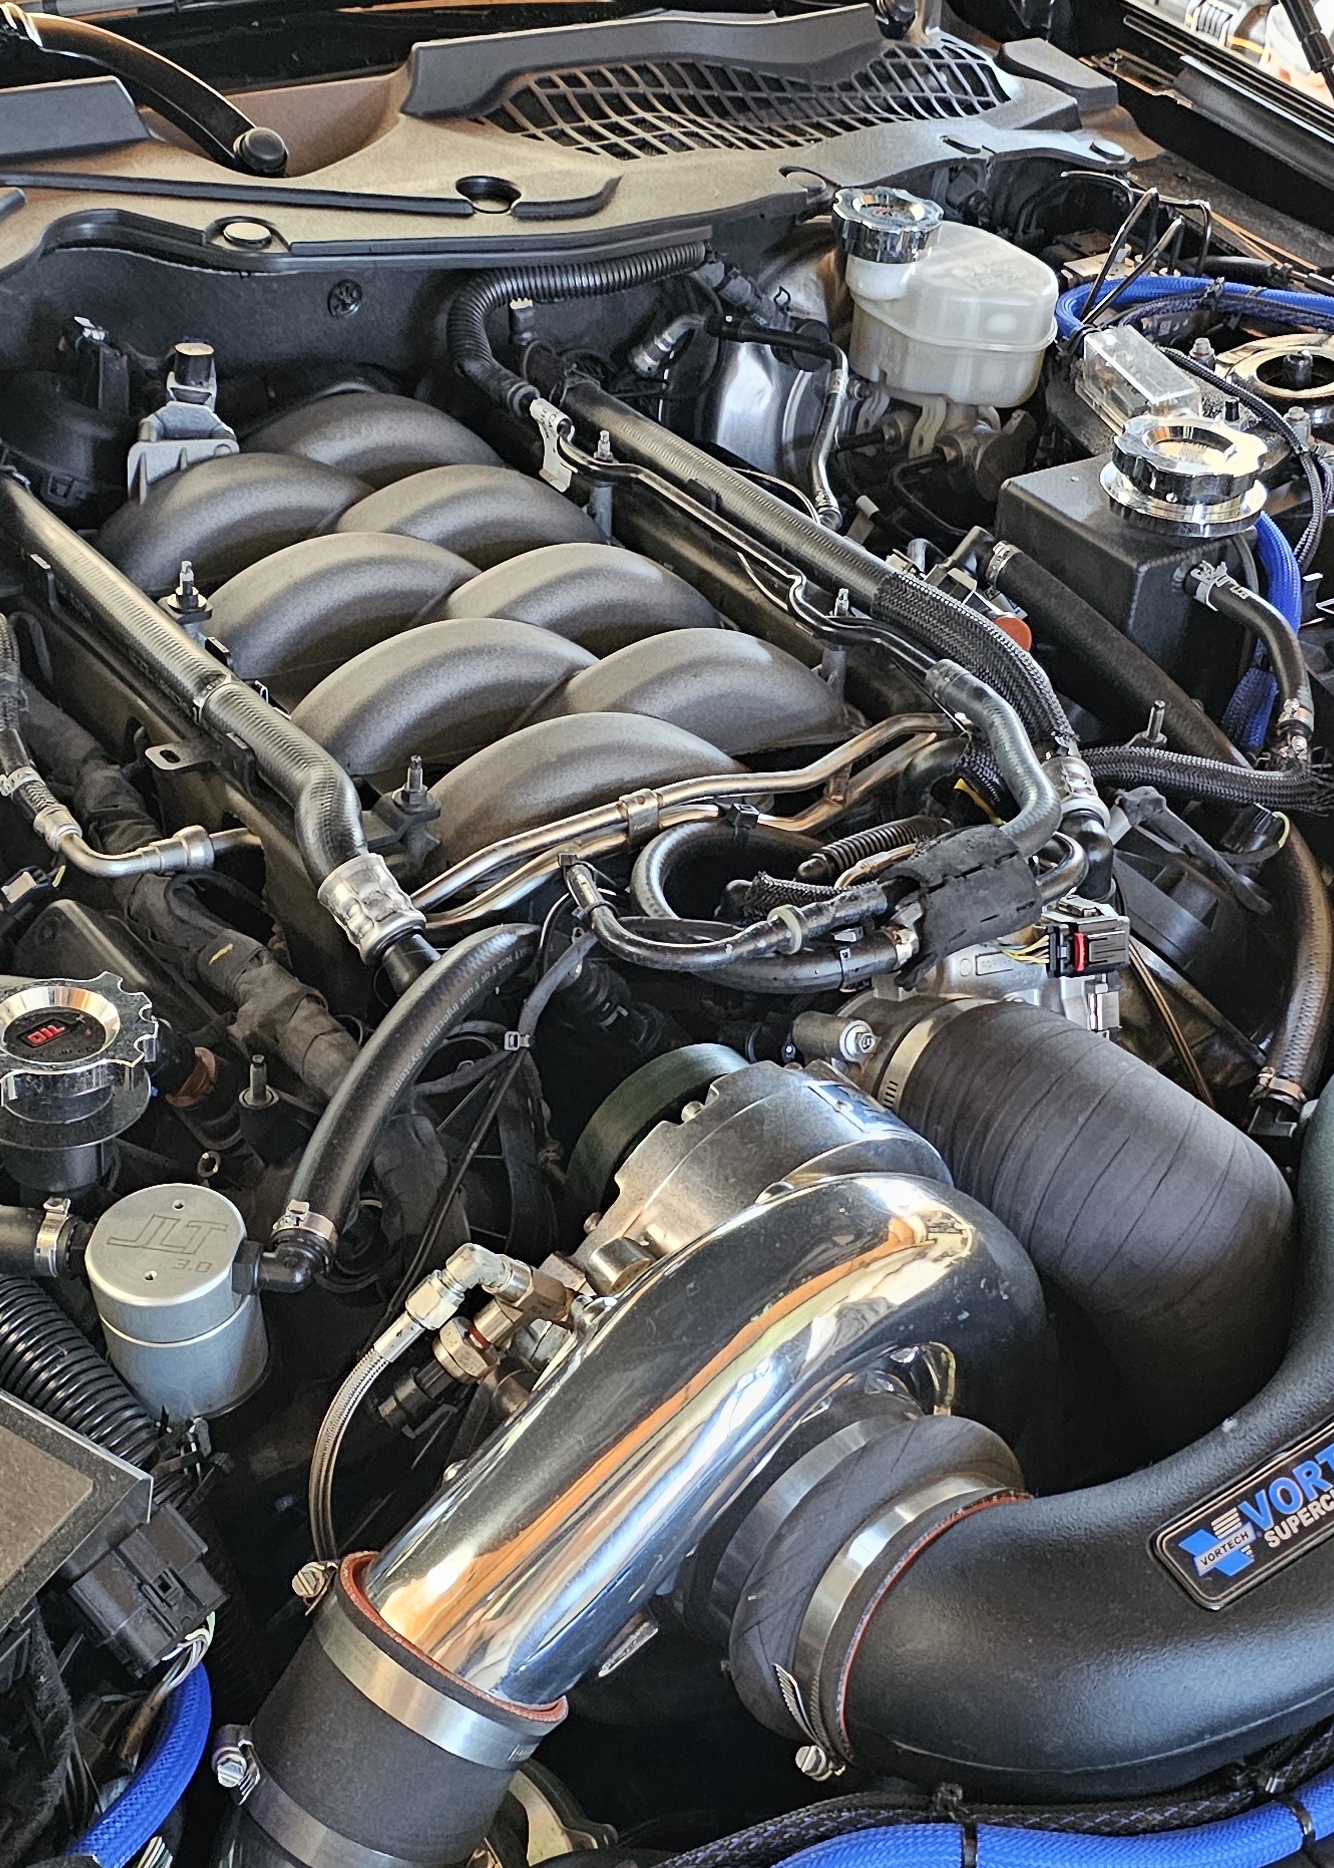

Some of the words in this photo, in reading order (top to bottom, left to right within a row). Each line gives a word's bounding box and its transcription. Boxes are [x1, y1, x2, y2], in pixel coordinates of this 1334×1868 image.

[479, 968, 498, 985] For
[458, 984, 481, 1006] Fuel
[27, 1024, 66, 1045] OIL
[423, 1004, 461, 1048] Injection
[389, 1048, 424, 1099] Systems
[107, 1213, 230, 1256] JLT
[172, 1258, 213, 1274] 3.0
[1199, 1529, 1251, 1567] VORTECH
